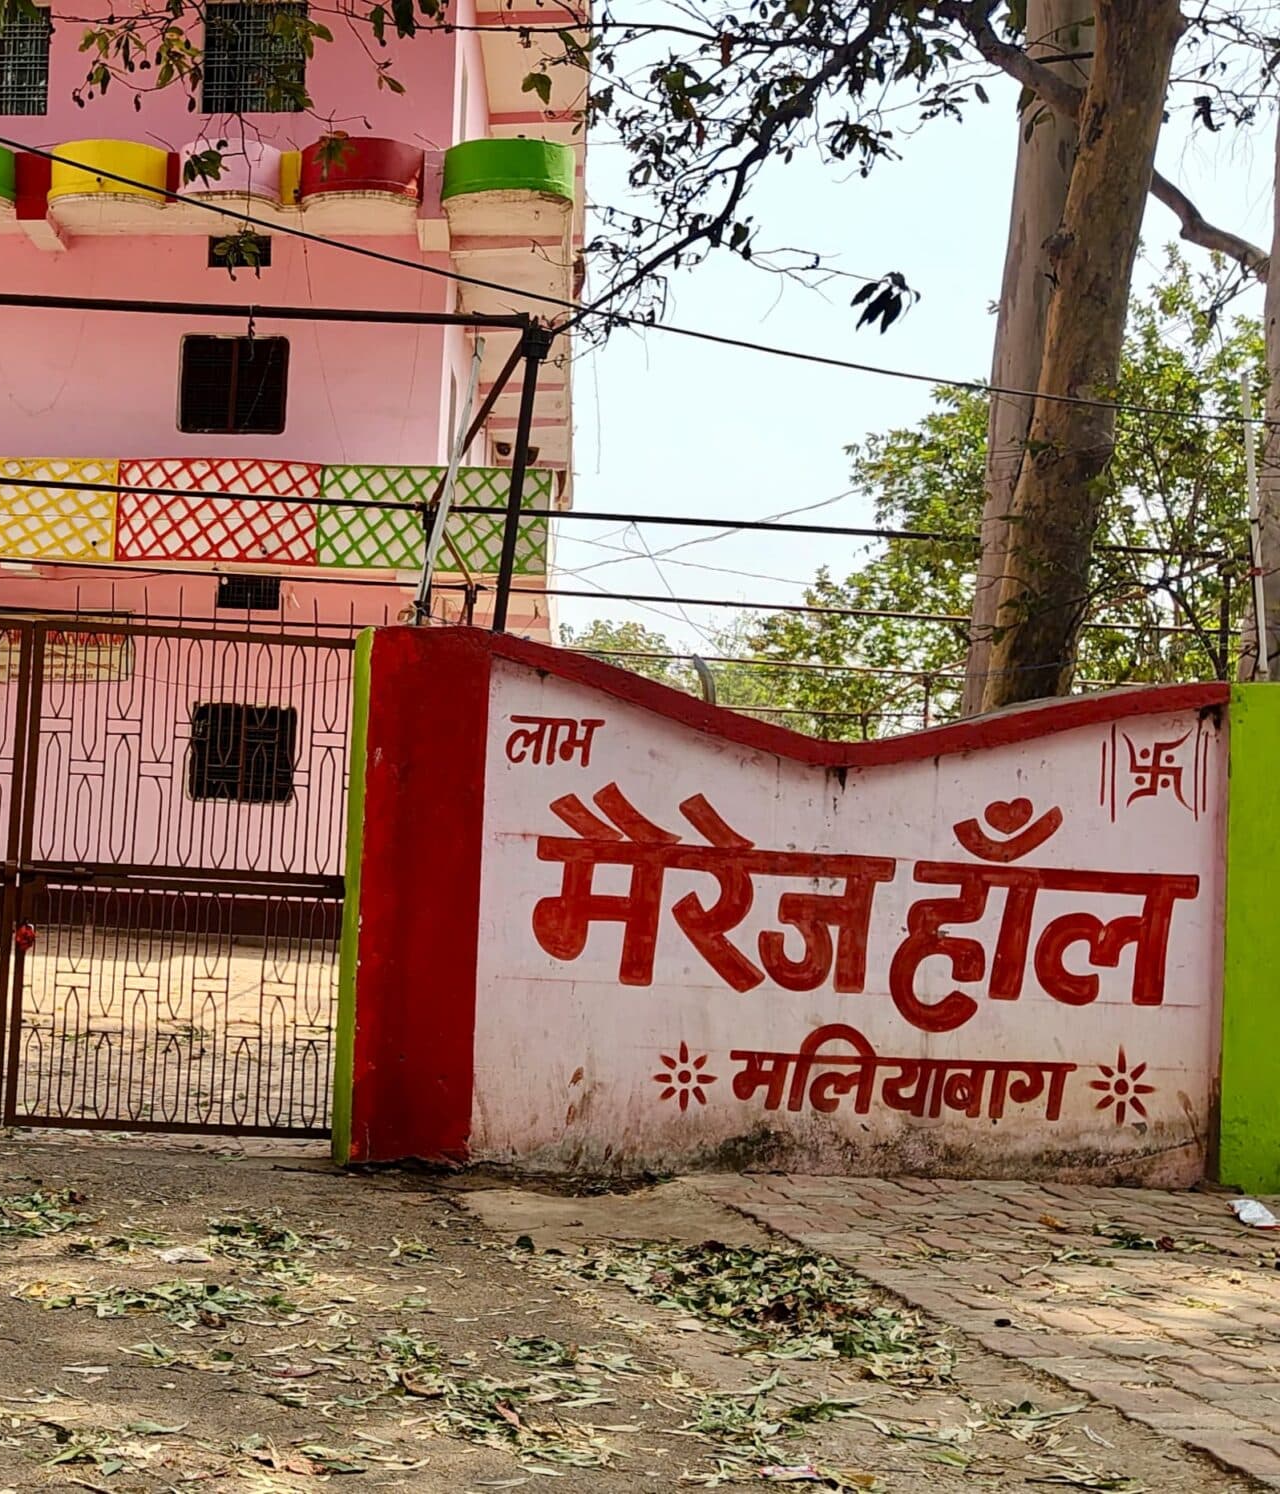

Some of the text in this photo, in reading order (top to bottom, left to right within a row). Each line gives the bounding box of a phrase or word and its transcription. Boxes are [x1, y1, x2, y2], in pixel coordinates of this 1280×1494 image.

[505, 714, 605, 767] लाभ
[531, 781, 897, 994] मैरेज
[729, 1023, 1077, 1122] मलियाबाग
